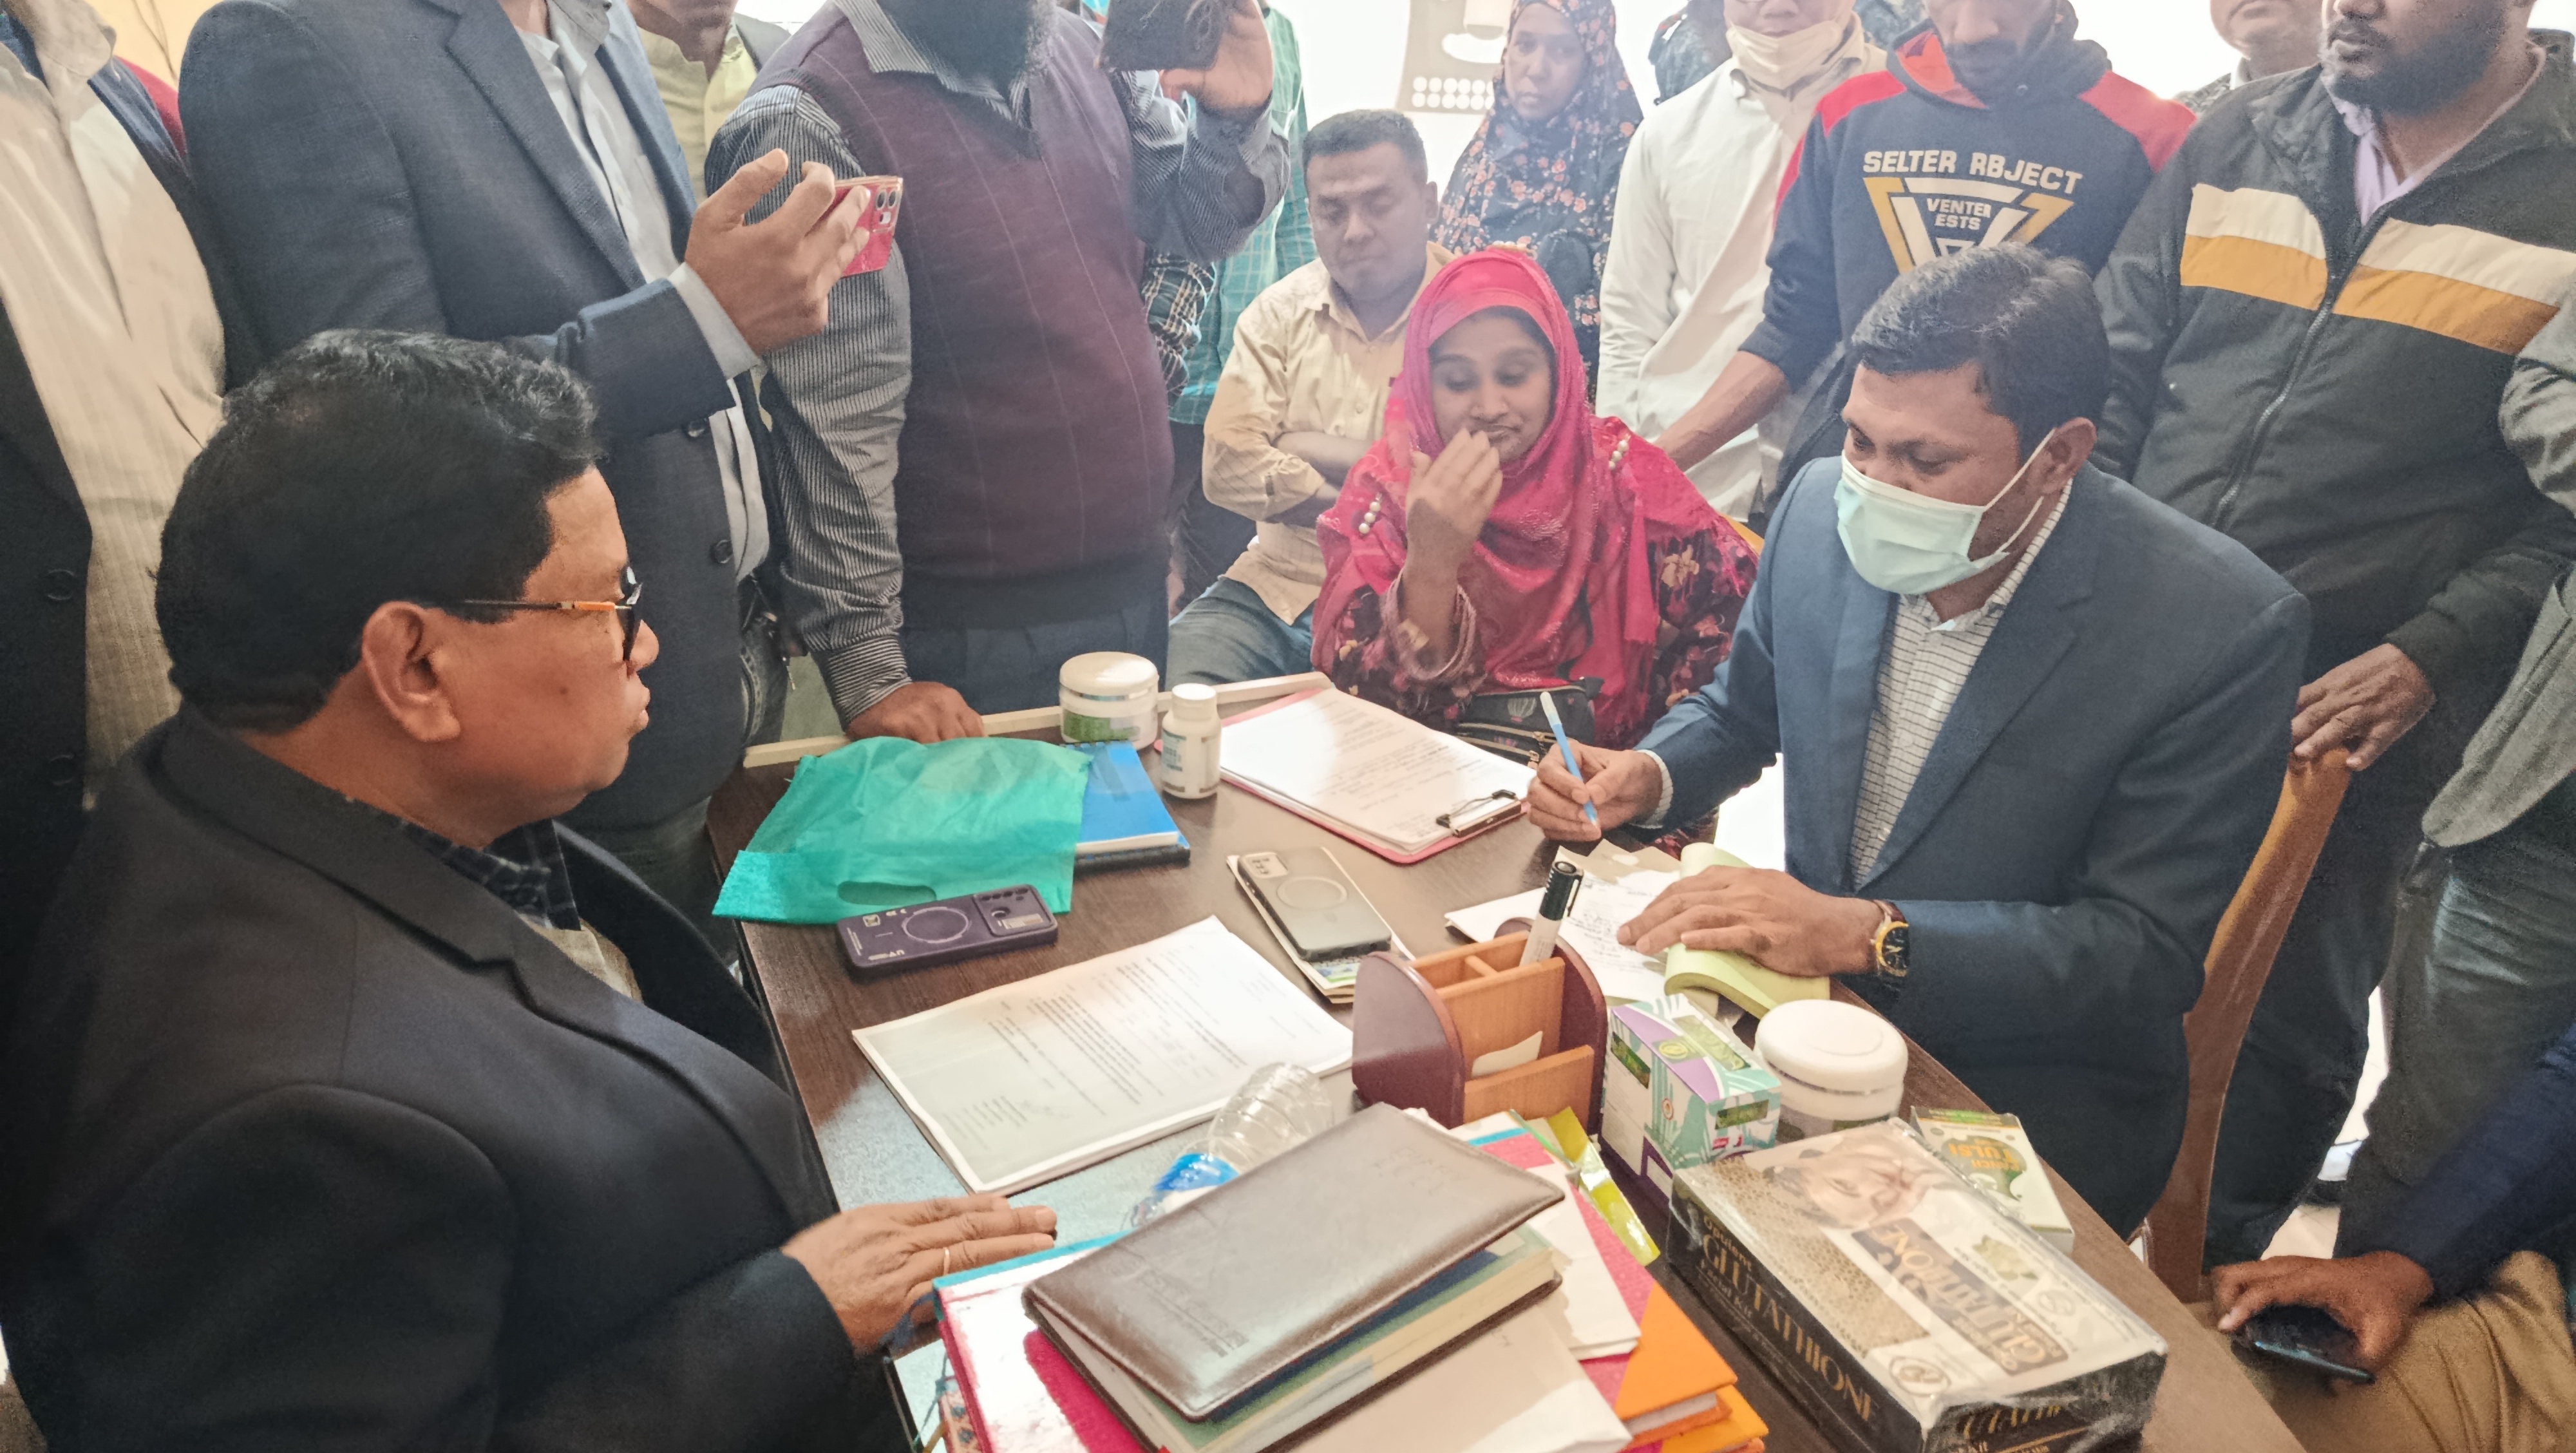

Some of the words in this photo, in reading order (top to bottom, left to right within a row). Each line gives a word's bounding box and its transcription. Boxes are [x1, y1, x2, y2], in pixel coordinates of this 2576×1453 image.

[1863, 150, 1957, 173] SELTER
[1969, 152, 2083, 194] RBJECT
[1927, 198, 1991, 218] VENTER
[1935, 213, 1981, 230] ESTS
[1949, 1143, 2014, 1163] TULSI
